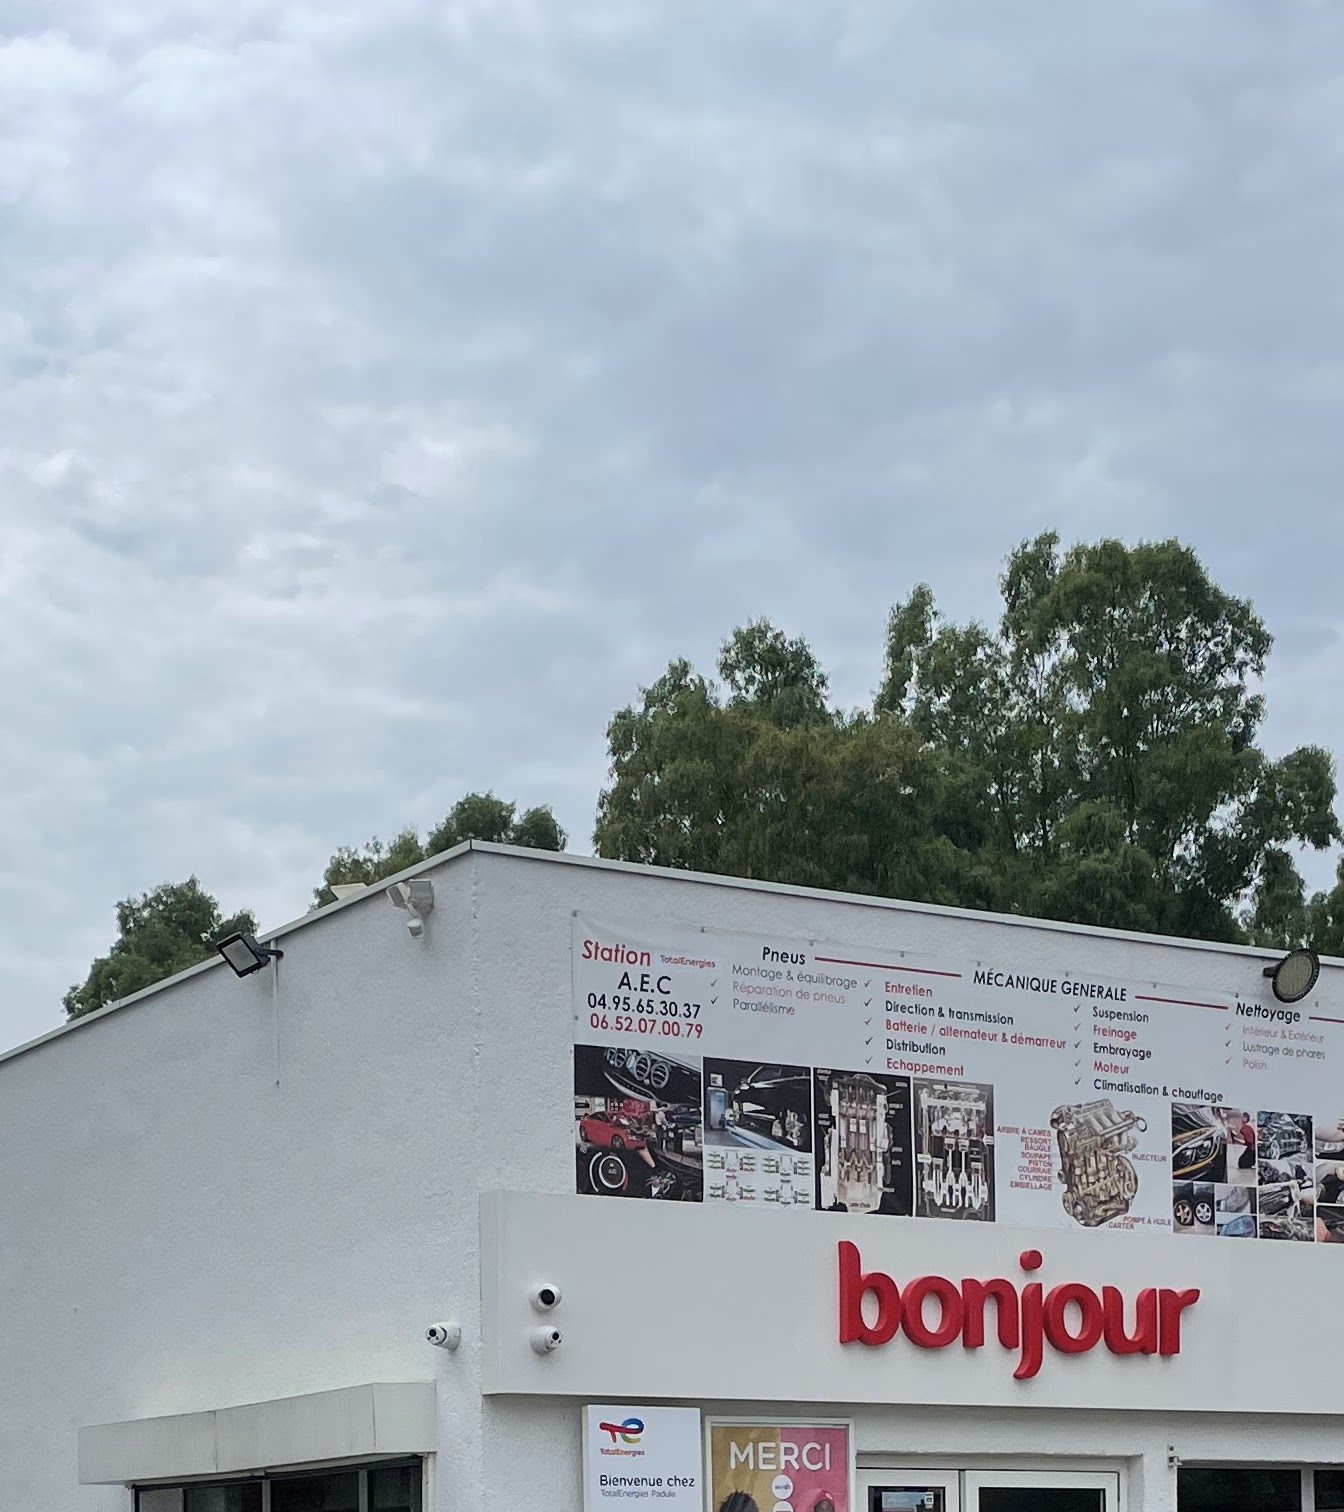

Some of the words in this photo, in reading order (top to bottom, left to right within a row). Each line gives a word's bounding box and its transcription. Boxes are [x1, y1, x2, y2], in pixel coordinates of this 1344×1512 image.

[582, 939, 651, 967] Station
[660, 954, 716, 969] TotalEnergies
[762, 946, 806, 965] Pneus
[617, 972, 672, 995] A.E.C
[732, 964, 783, 981] Montage
[786, 969, 794, 981] &
[797, 971, 858, 990] équilibrage
[973, 968, 1057, 994] MÉCANIQUE
[1061, 980, 1127, 1001] GENERALE
[733, 981, 792, 998] Réparation
[795, 988, 810, 1000] de
[813, 992, 846, 1005] pneus
[885, 981, 933, 997] Entretien
[587, 993, 701, 1019] 04.95.65.30.37
[733, 998, 795, 1016] Parallélisme
[885, 1000, 935, 1017] Direction
[937, 1006, 945, 1018] &
[948, 1007, 1014, 1025] transmission
[1092, 1006, 1149, 1023] Suspension
[1236, 1002, 1301, 1024] Nettoyage
[590, 1013, 703, 1039] 06.52.07.00.79
[885, 1019, 927, 1034] Batterie
[930, 1024, 936, 1036] /
[939, 1025, 997, 1042] alternateur
[1001, 1032, 1008, 1044] &
[1010, 1031, 1066, 1049] démarreur
[1093, 1024, 1137, 1041] Freinage
[1281, 1030, 1287, 1040] &
[886, 1038, 946, 1056] Distribution
[1093, 1042, 1152, 1060] Embrayage
[1243, 1041, 1280, 1056] Lustrage
[1282, 1046, 1294, 1056] de
[1296, 1048, 1326, 1060] phares
[886, 1057, 964, 1076] Echappement
[1093, 1060, 1129, 1075] Moteur
[1243, 1058, 1267, 1070] Polish
[1093, 1078, 1159, 1097] Climatisation
[1162, 1085, 1169, 1097] &
[1171, 1086, 1224, 1102] chauffage
[838, 1240, 1200, 1380] bonjour
[730, 1441, 831, 1471] MERCI
[600, 1474, 663, 1487] Bienvenue
[666, 1474, 695, 1487] chez
